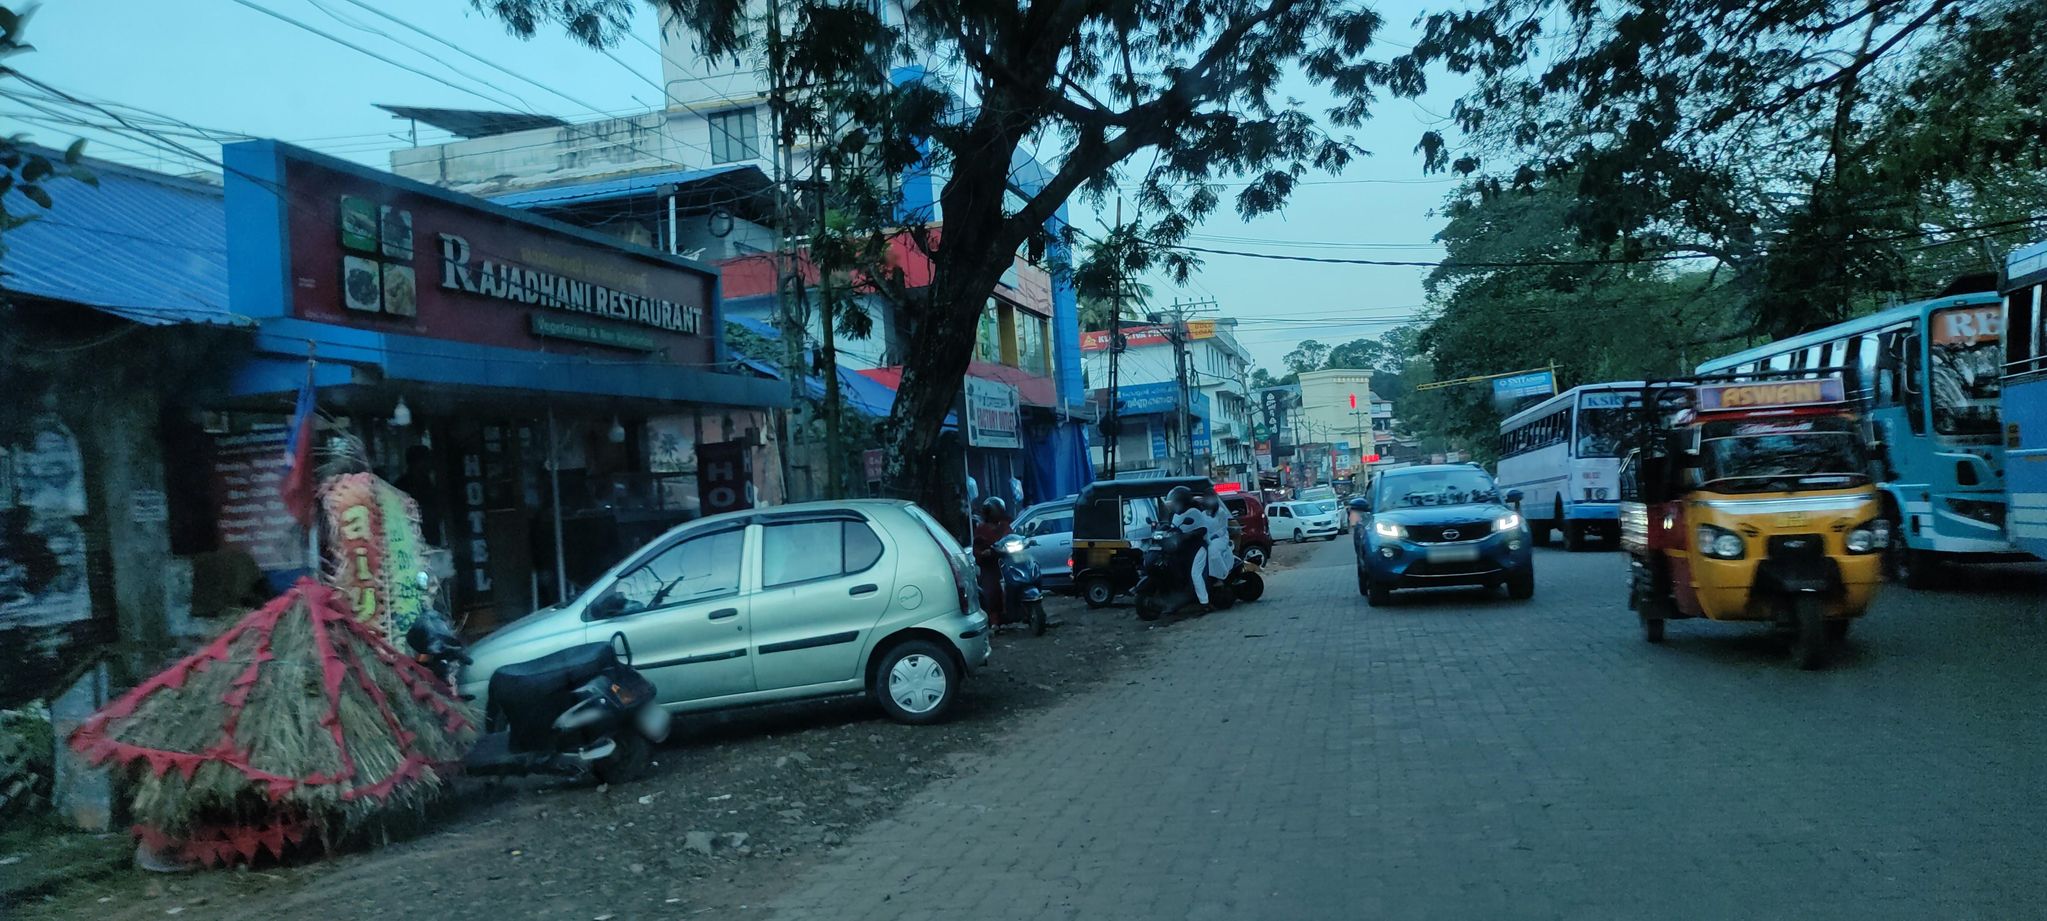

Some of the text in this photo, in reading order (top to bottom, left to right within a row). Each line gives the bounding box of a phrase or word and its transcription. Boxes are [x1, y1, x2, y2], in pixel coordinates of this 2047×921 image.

[438, 232, 593, 314] RAJADHANI
[596, 285, 703, 335] RESTAURANT
[464, 454, 493, 592] HOTEL
